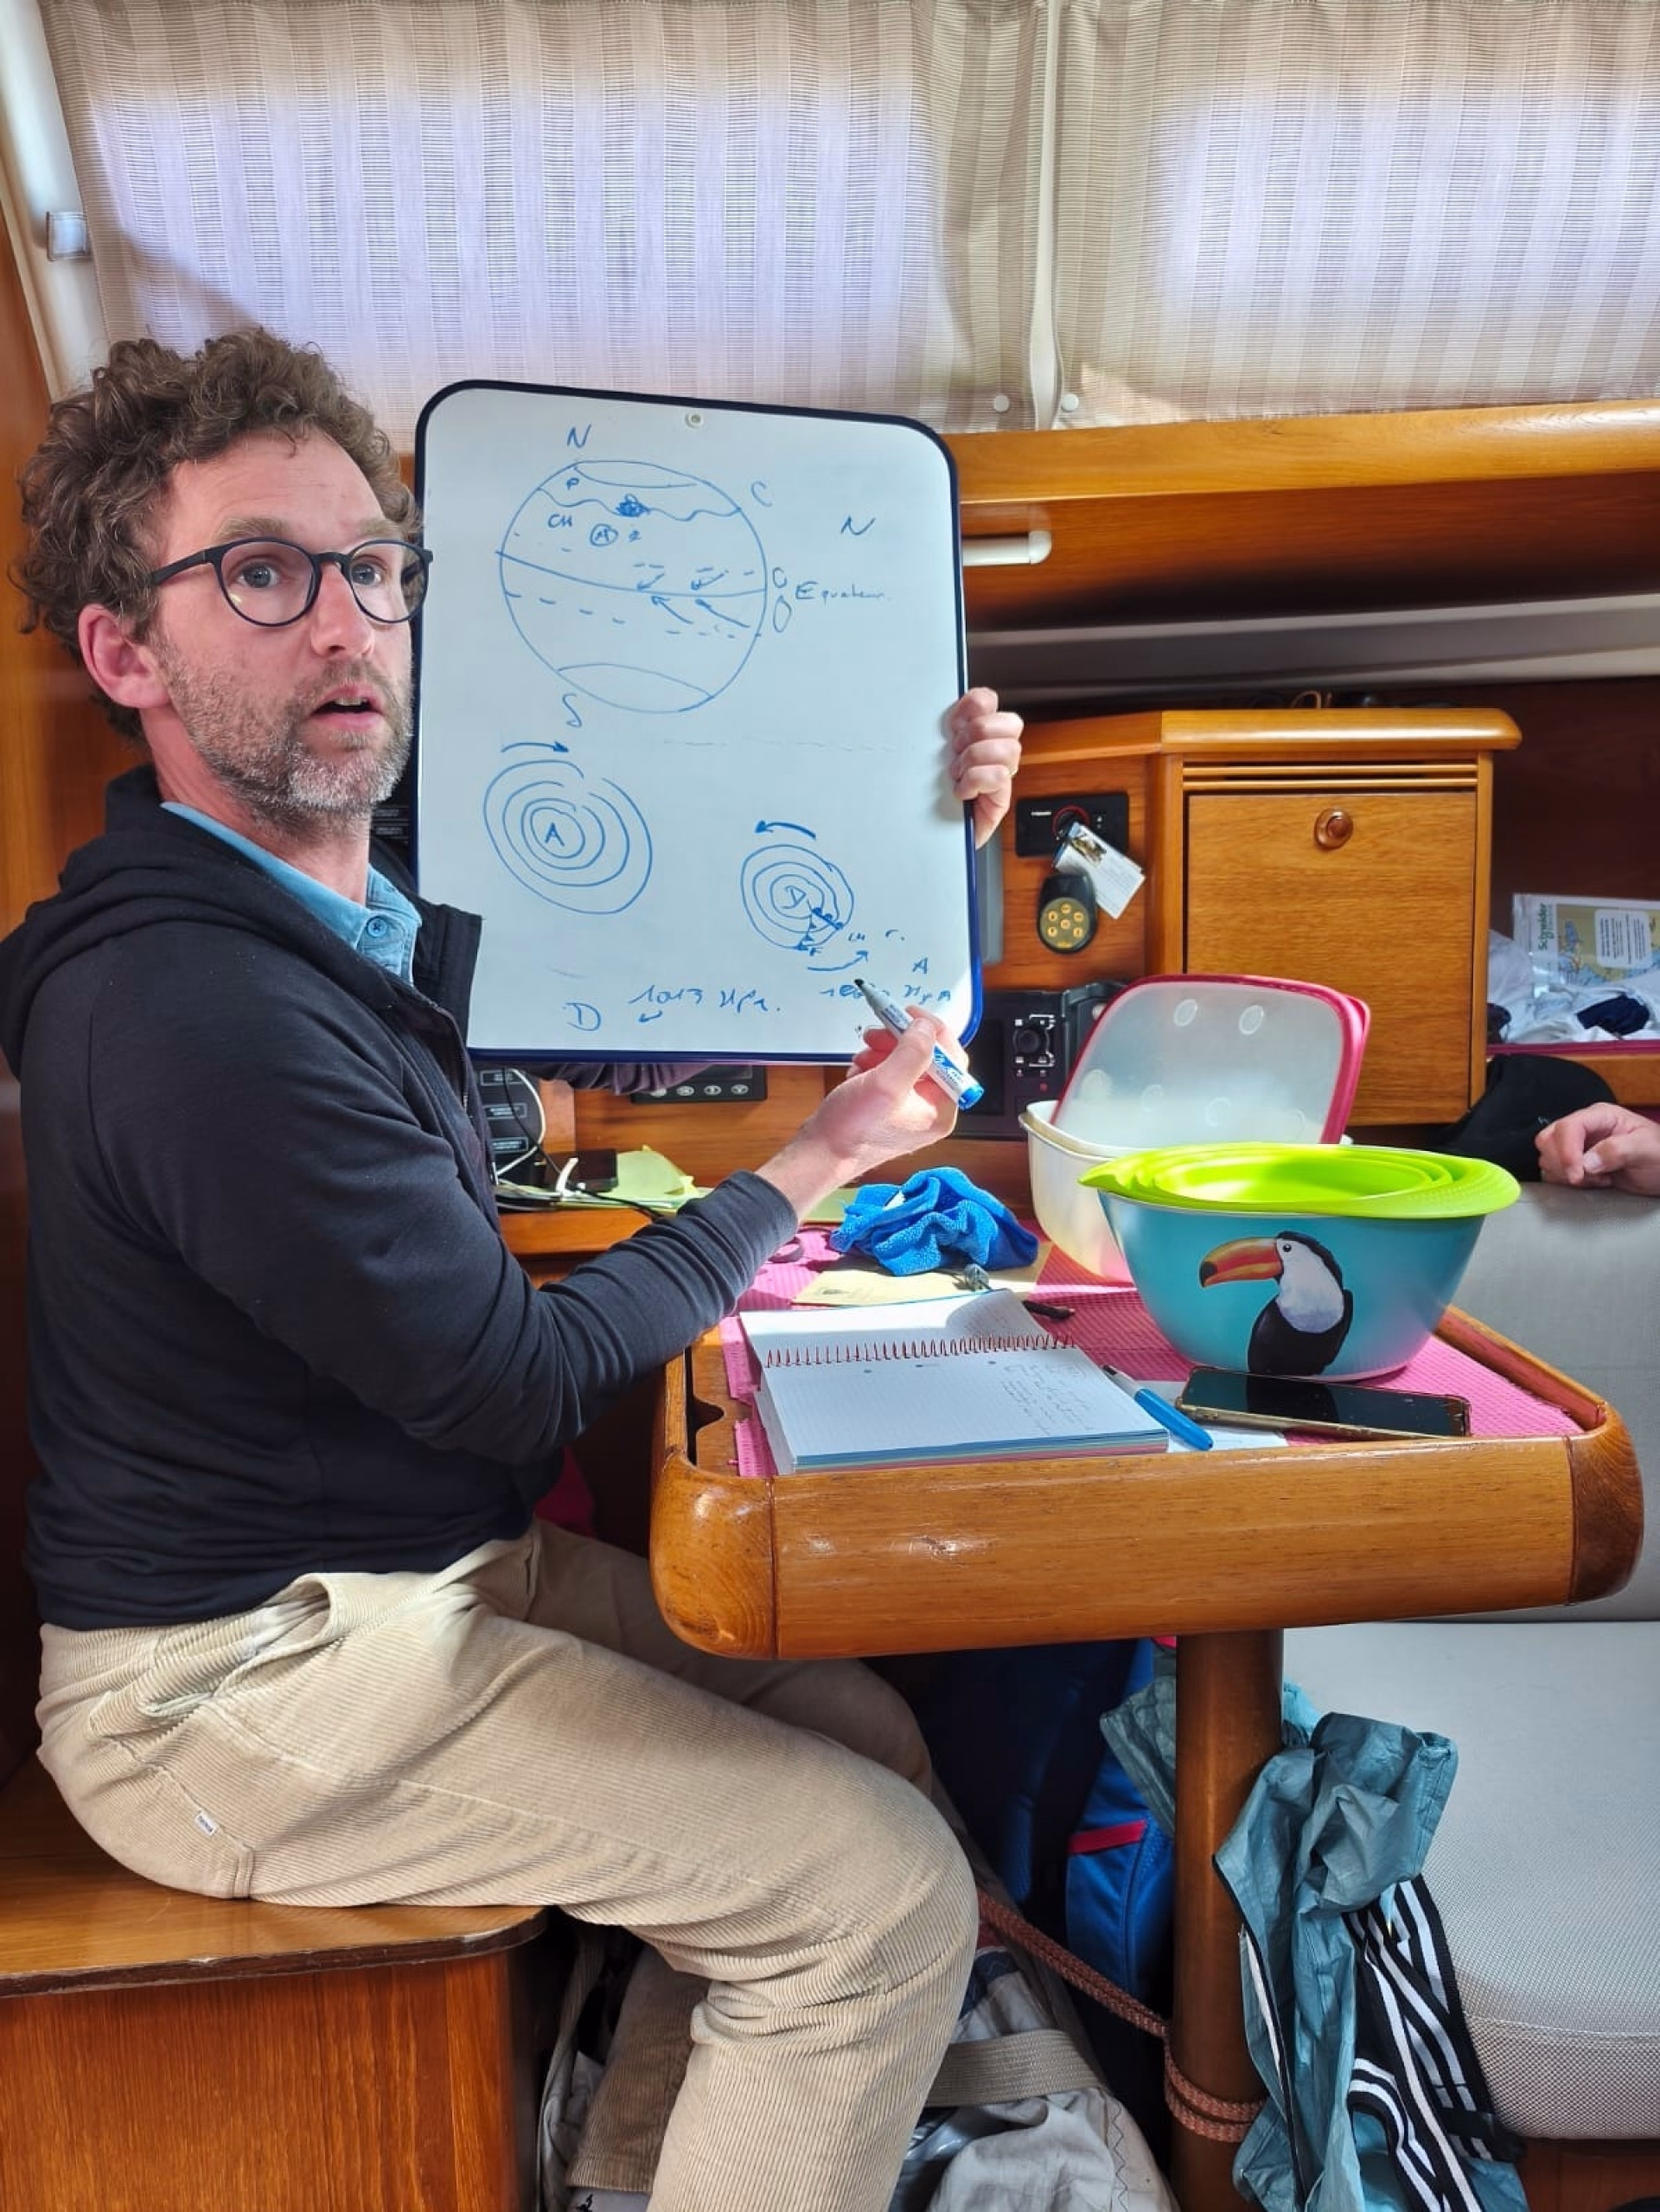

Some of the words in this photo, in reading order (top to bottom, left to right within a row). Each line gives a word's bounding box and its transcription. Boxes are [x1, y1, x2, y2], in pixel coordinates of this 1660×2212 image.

[566, 423, 592, 449] N
[545, 822, 565, 847] A
[912, 957, 929, 975] A
